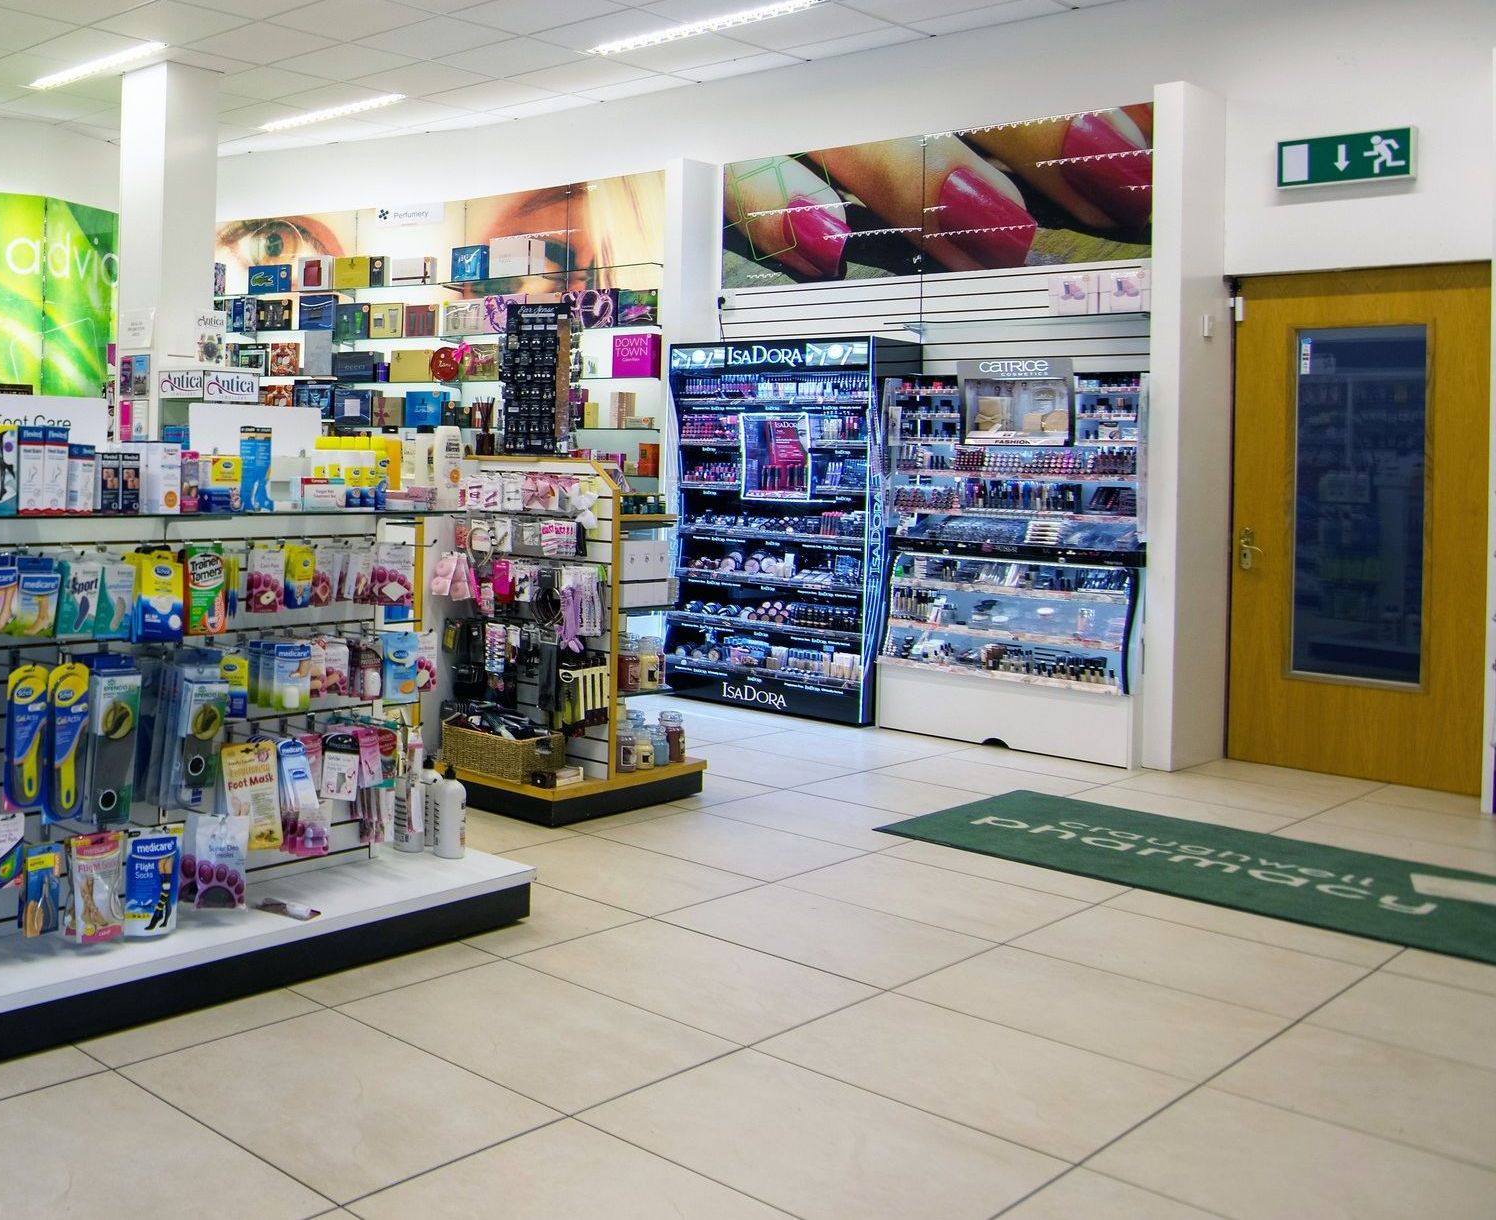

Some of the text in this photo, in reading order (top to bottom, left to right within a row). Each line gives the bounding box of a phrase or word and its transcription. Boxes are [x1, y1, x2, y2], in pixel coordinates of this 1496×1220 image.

[393, 210, 430, 219] Perfumery
[198, 315, 224, 327] Antica
[615, 337, 648, 348] DOWN
[615, 347, 648, 357] TOWN
[160, 371, 203, 393] Antica
[207, 375, 254, 396] Antica
[33, 414, 72, 427] Care
[190, 557, 219, 571] Trainer
[22, 581, 58, 590] medicare
[278, 650, 310, 658] medicare
[228, 773, 275, 792] Foot Mask
[136, 841, 173, 853] medicare
[1059, 820, 1374, 887] craughwell
[135, 862, 155, 872] Flight
[970, 815, 1438, 916] pharmacy
[135, 871, 154, 879] Socks
